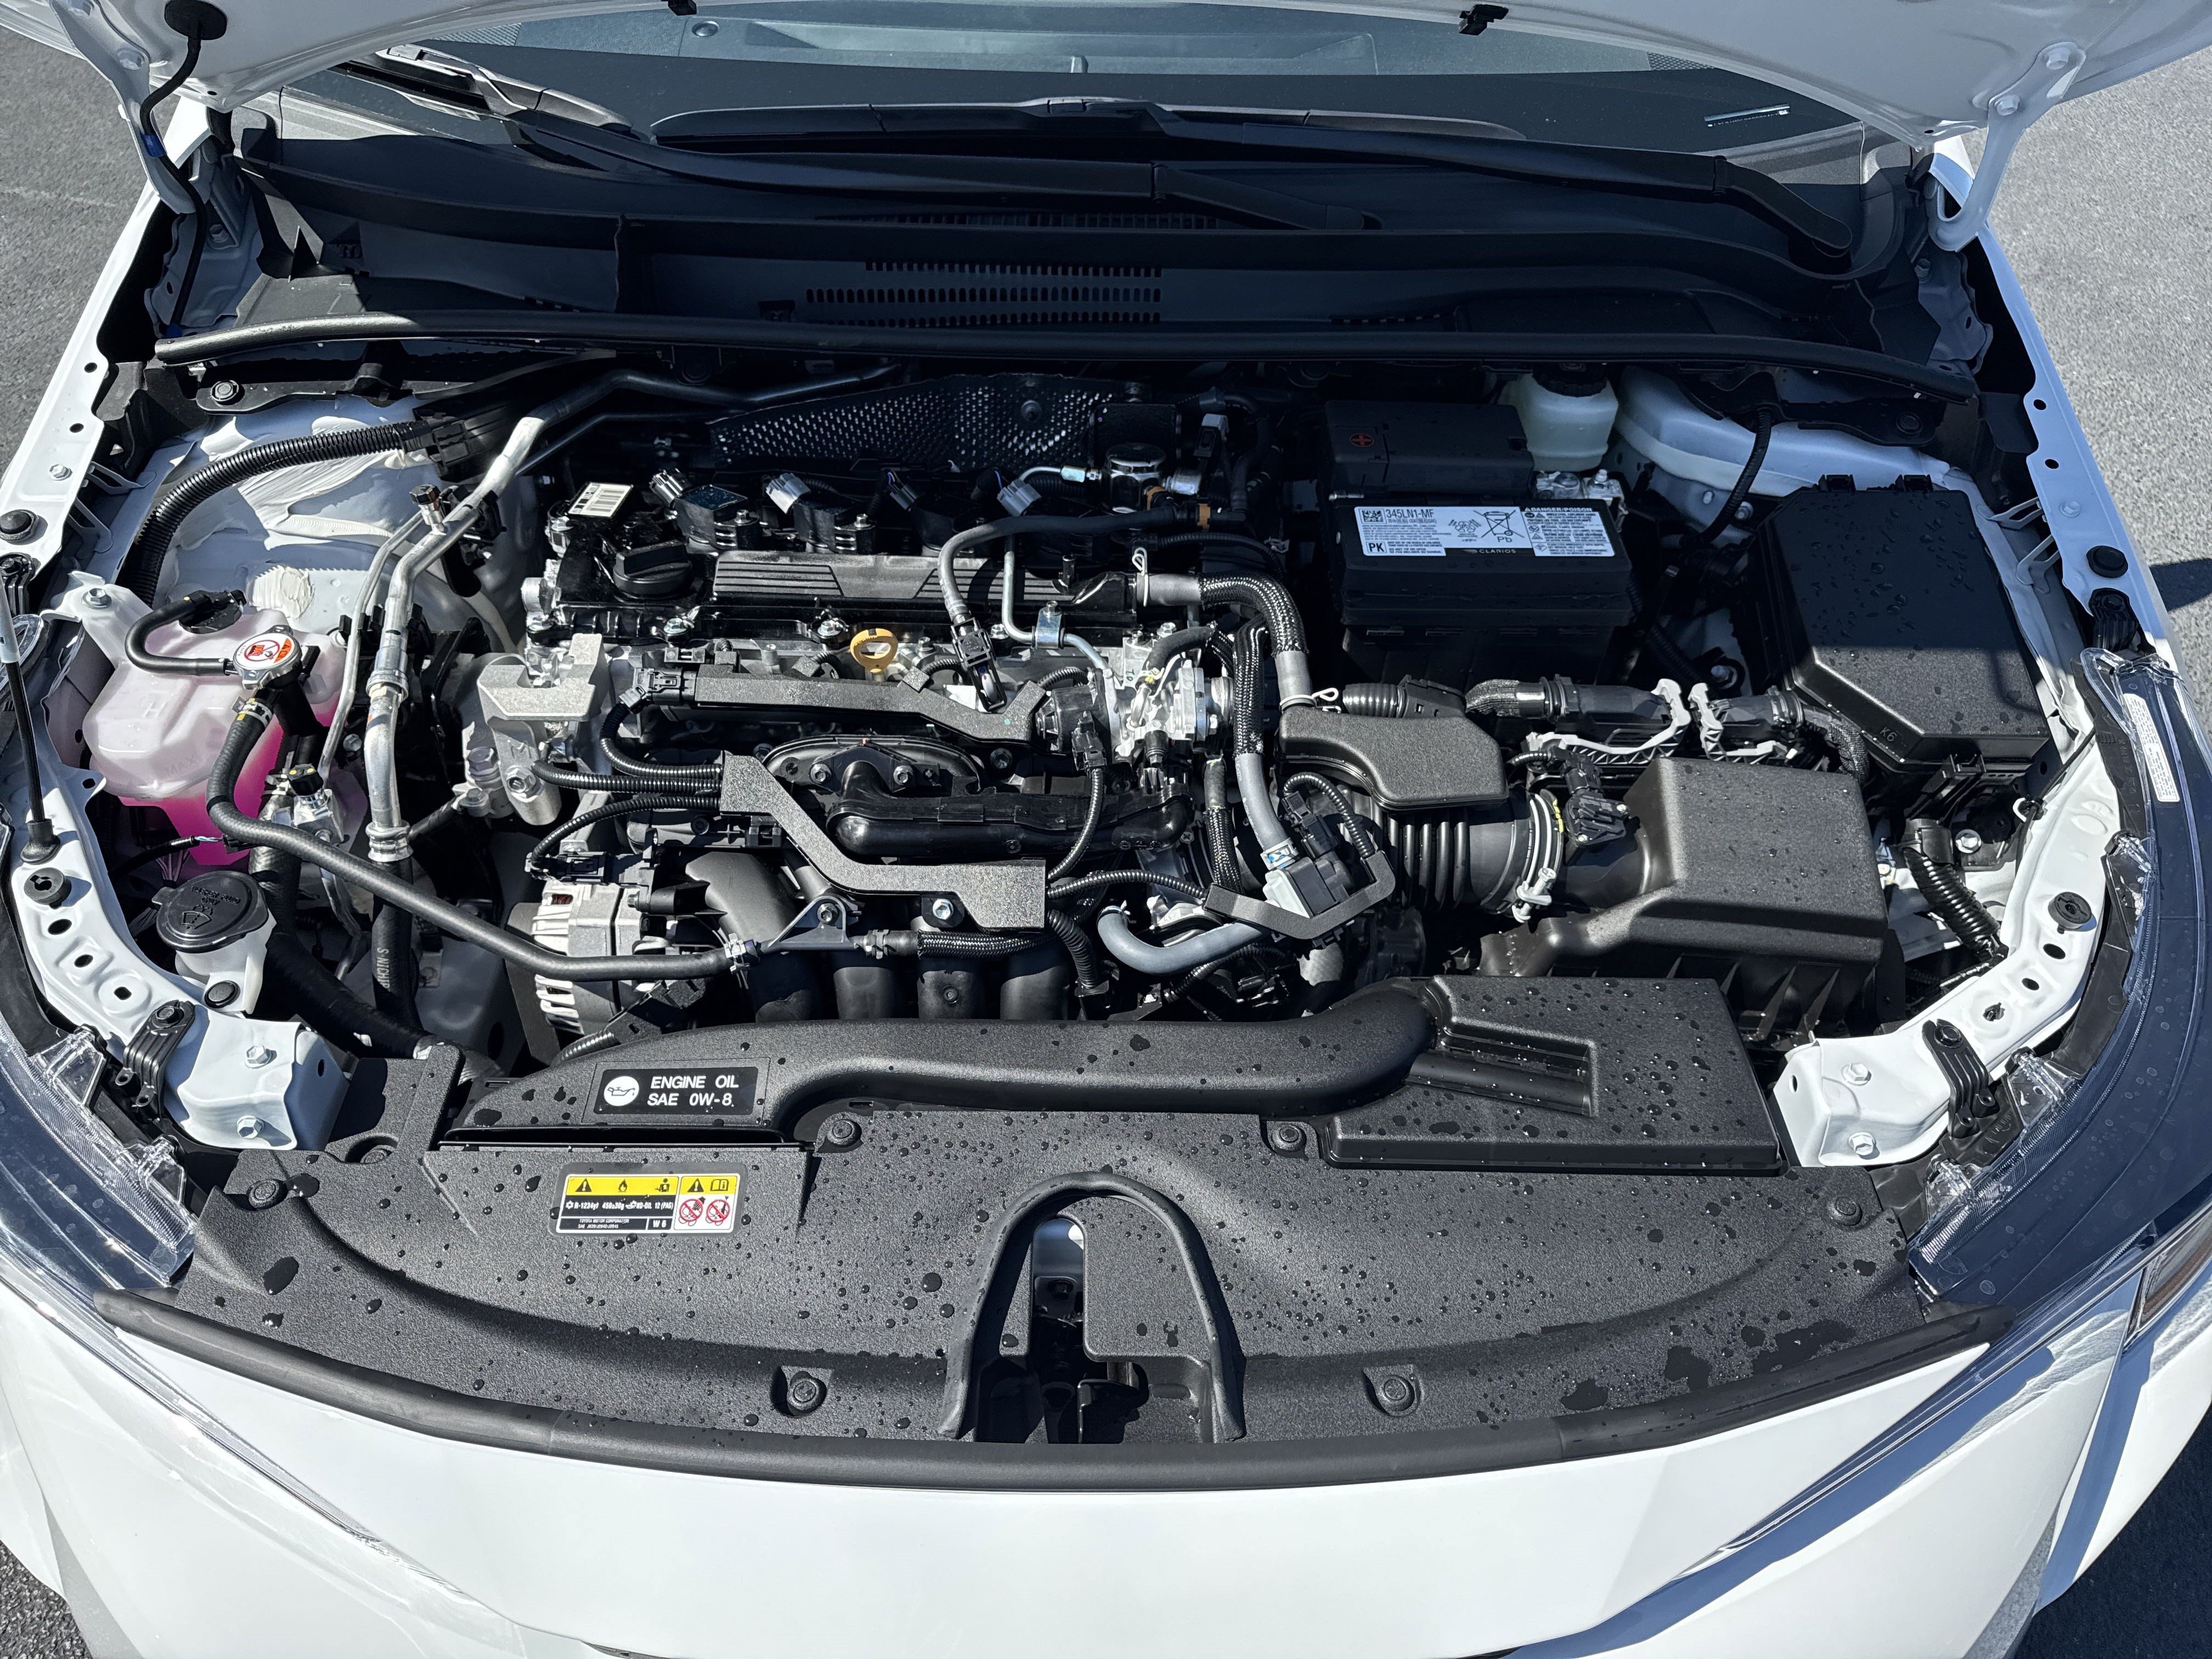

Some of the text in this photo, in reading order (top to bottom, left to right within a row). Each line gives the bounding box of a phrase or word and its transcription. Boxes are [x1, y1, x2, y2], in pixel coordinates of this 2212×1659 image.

[1386, 509, 1434, 519] 345LN1-MF
[1496, 535, 1513, 543] Pb
[1368, 543, 1385, 552] PK
[1879, 726, 1897, 742] K6
[650, 1075, 739, 1089] ENGINE OIL
[647, 1092, 732, 1107] SAE 0W-8
[574, 1201, 599, 1211] R-1234yf
[661, 1201, 674, 1210] (PAG)
